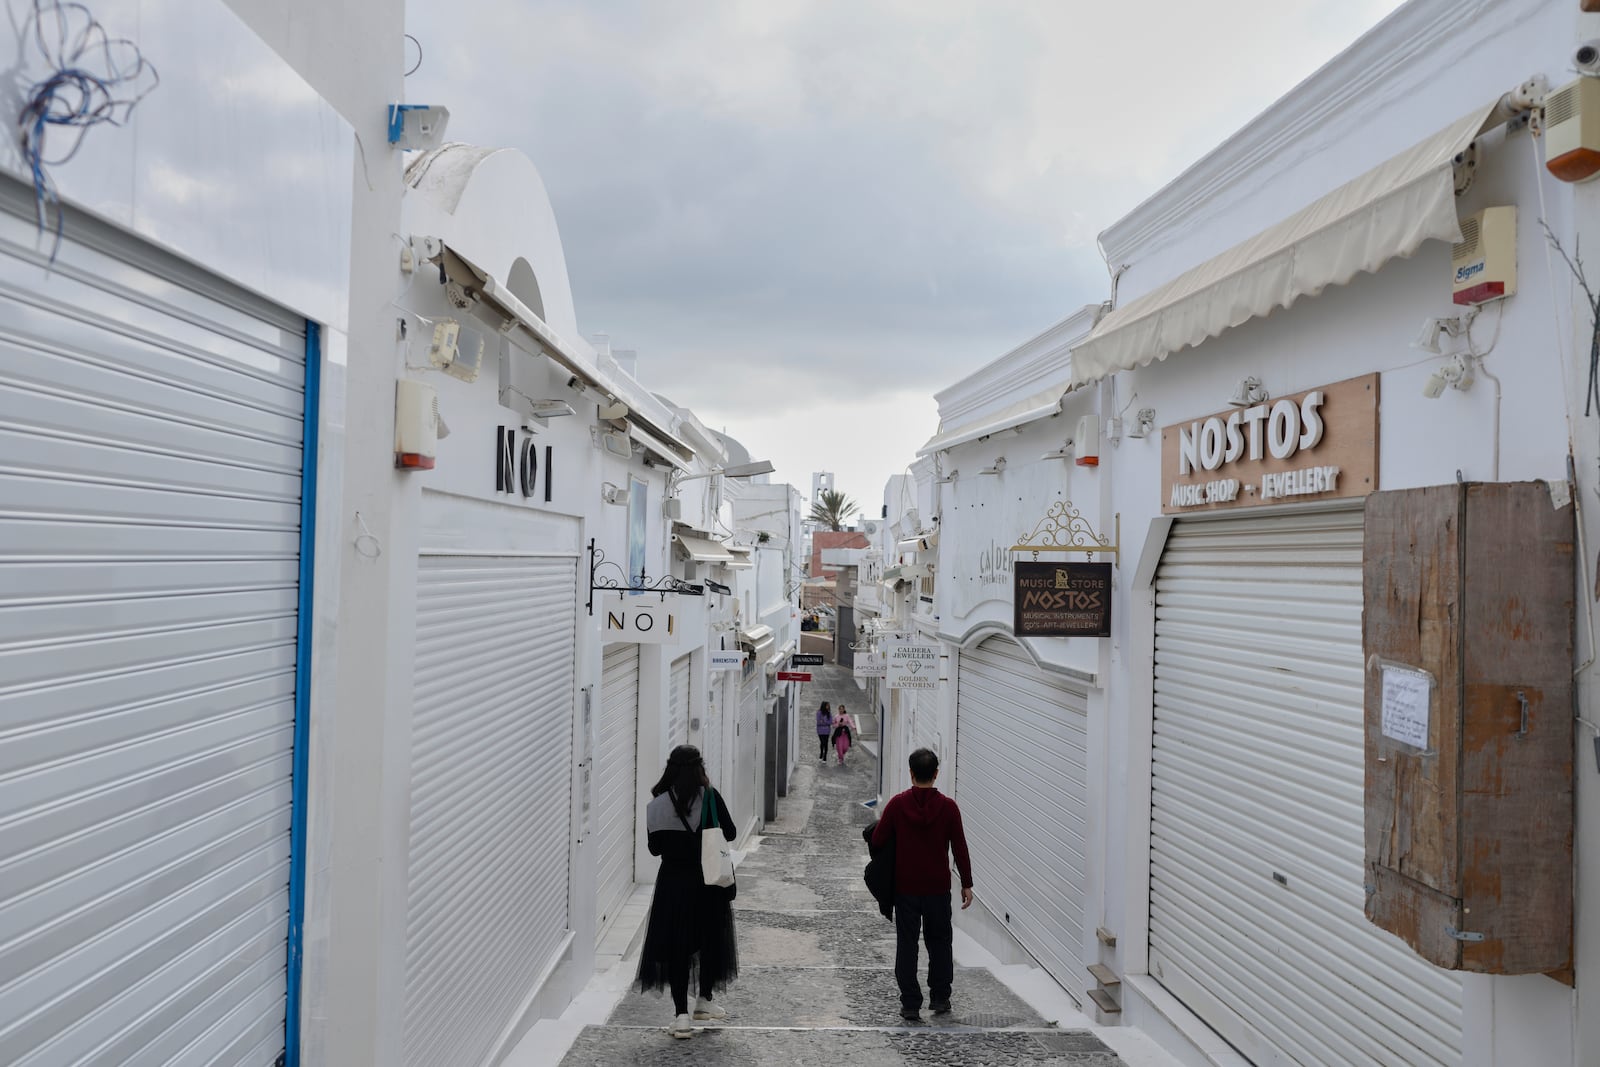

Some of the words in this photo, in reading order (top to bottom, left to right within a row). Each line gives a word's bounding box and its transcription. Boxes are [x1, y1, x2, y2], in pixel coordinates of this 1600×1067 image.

[1455, 261, 1485, 283] Sigma
[1178, 390, 1325, 475] NOSTOS
[1170, 483, 1206, 507] MUSIC
[1205, 478, 1240, 502] SHOP
[1261, 465, 1341, 500] JEWELLERY
[1020, 578, 1054, 589] MUSIC
[1071, 579, 1104, 589] STORE
[1022, 590, 1102, 610] NOSTOS
[1023, 612, 1052, 620] MUSICAL
[1053, 612, 1099, 620] INSTRUMENTS
